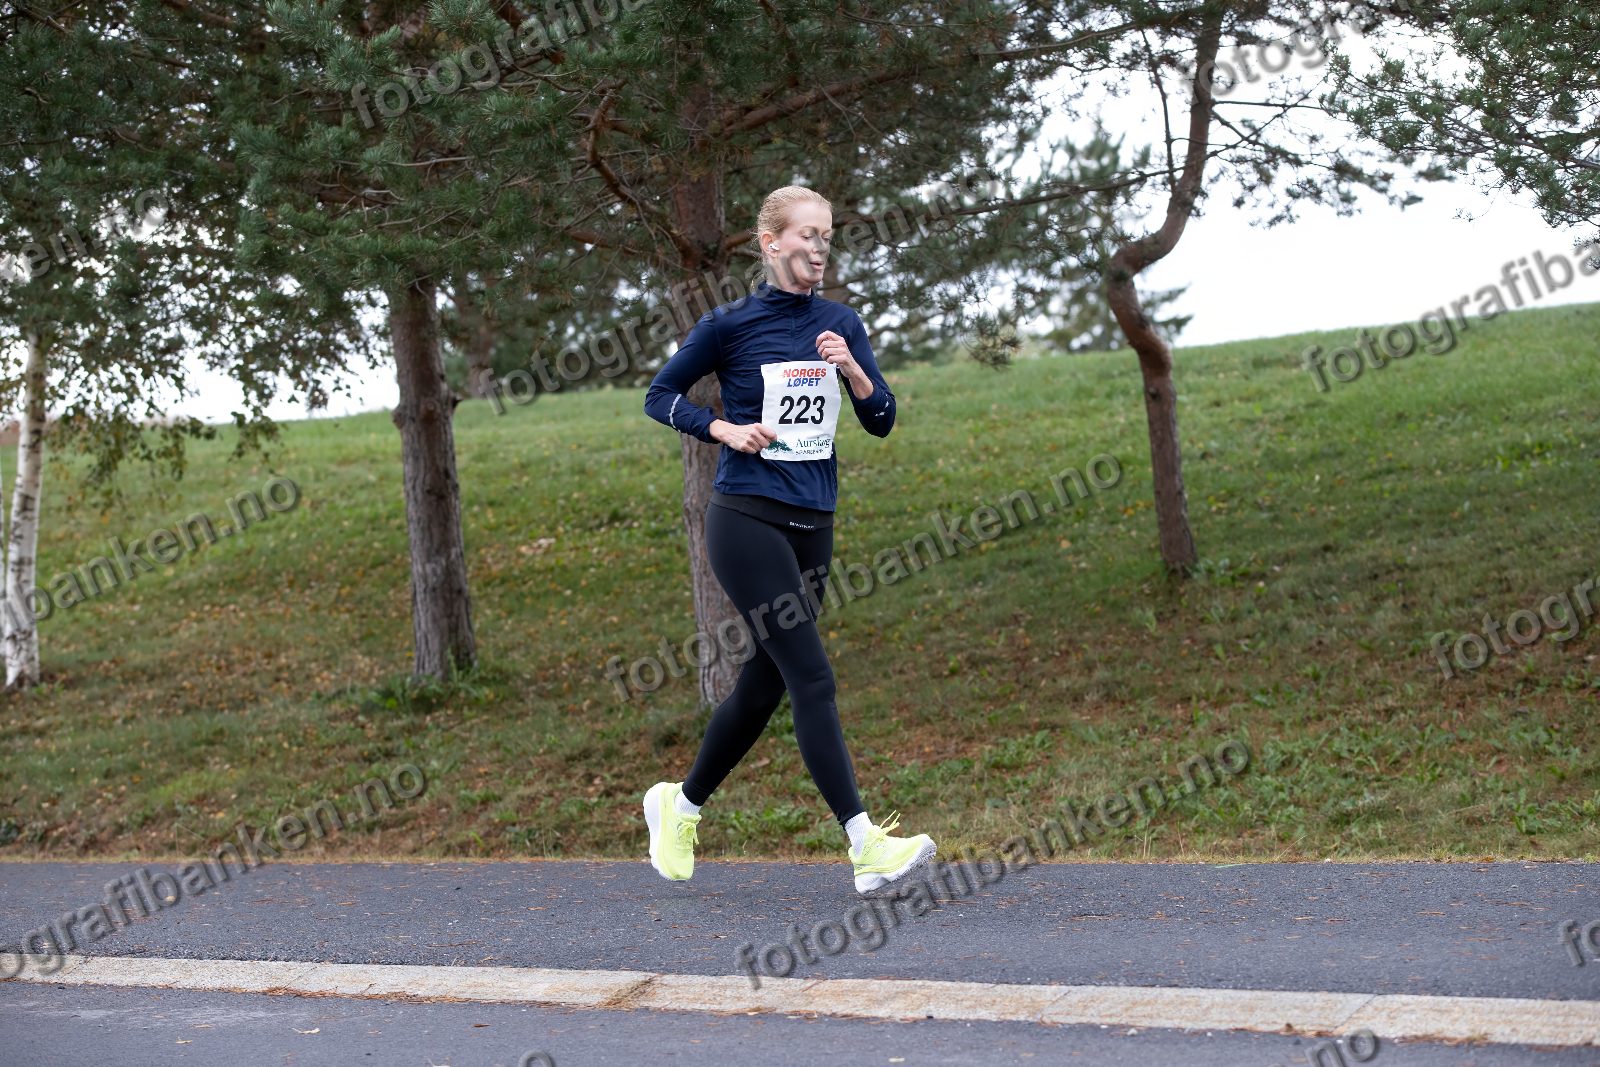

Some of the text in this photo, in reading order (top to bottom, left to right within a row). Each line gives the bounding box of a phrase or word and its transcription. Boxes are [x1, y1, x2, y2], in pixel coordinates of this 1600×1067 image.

[783, 368, 827, 379] NORGES
[787, 378, 821, 388] LØPET
[778, 395, 826, 425] 223
